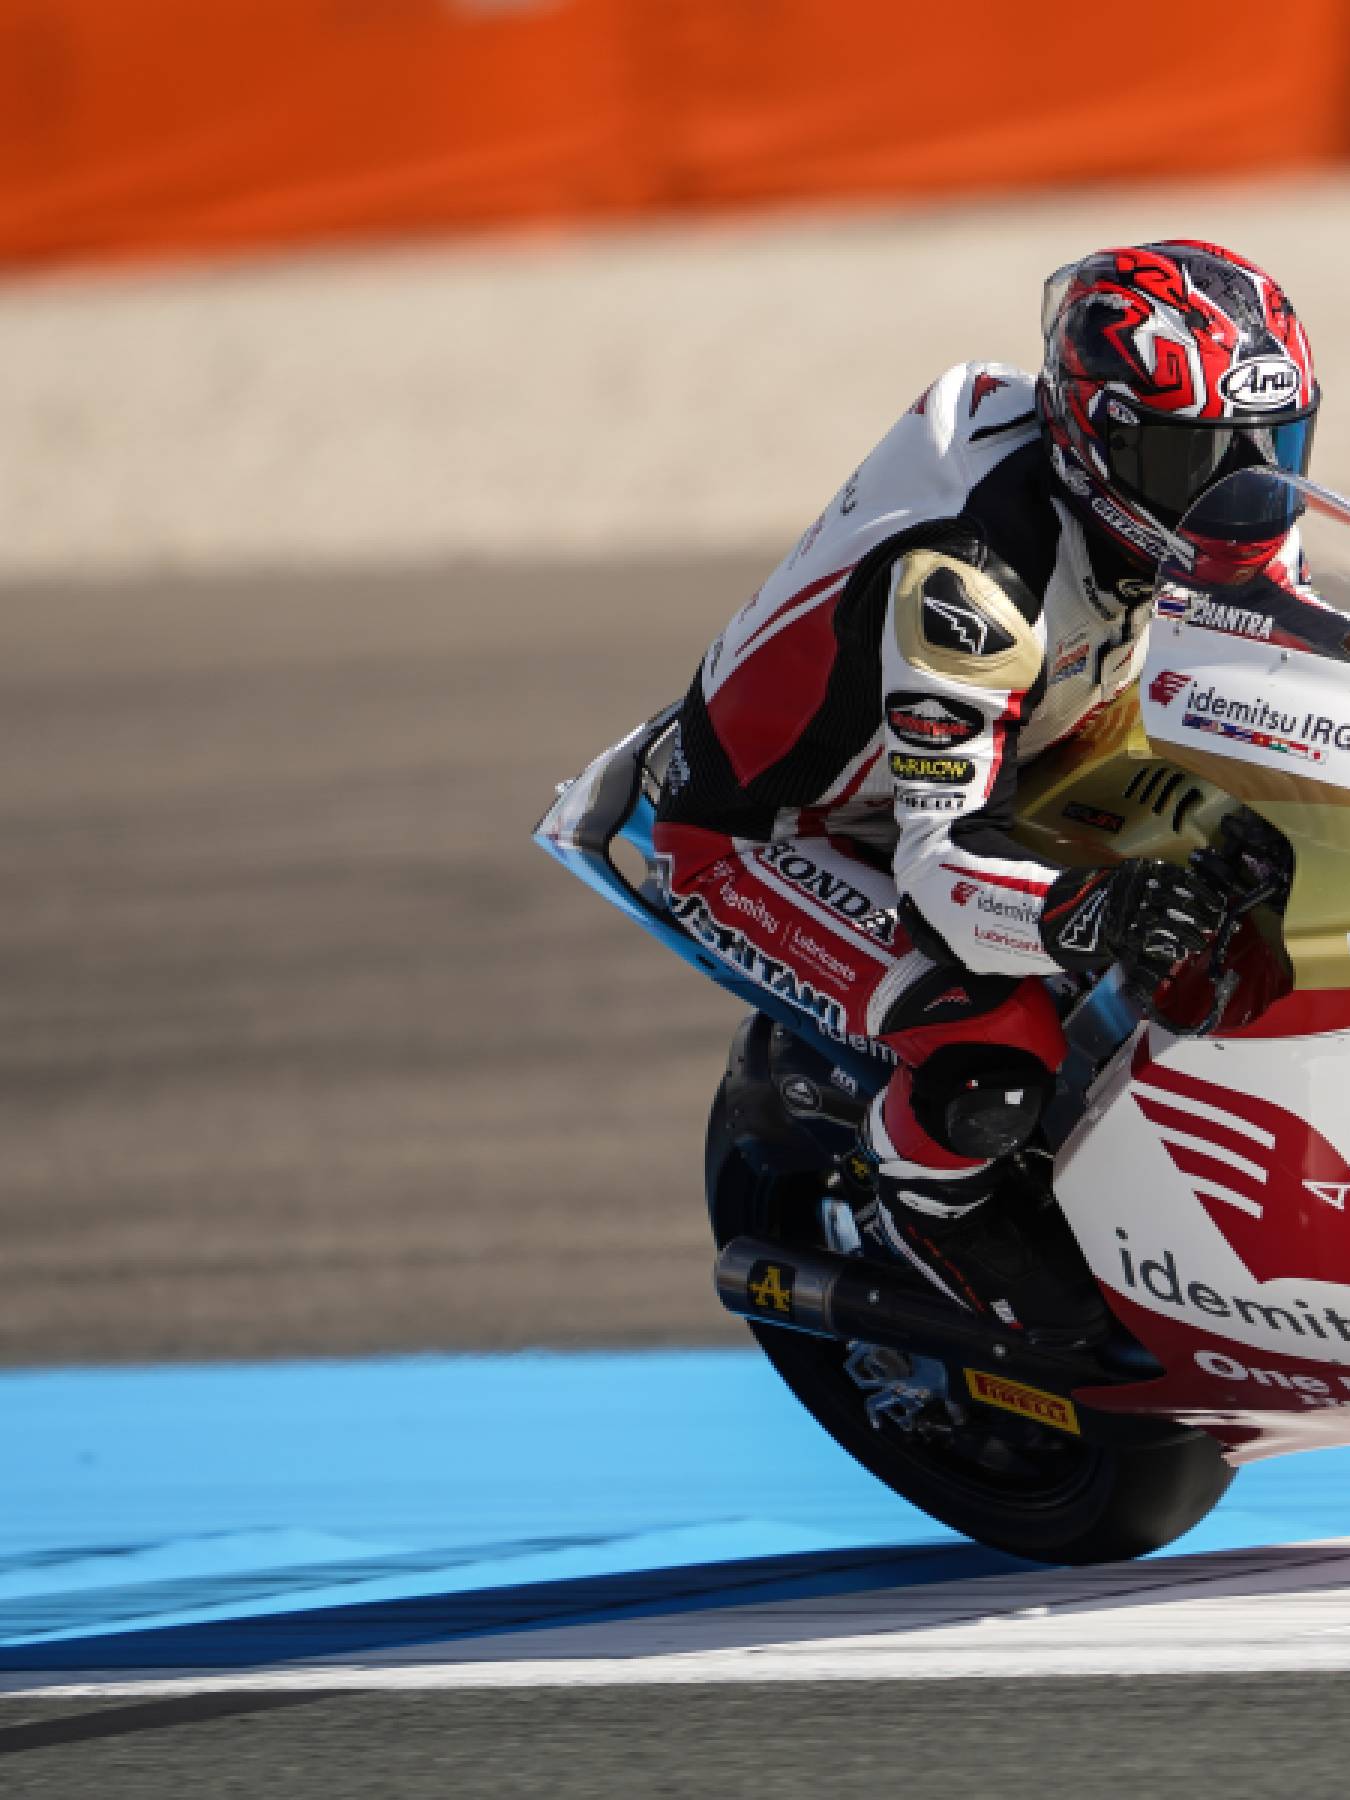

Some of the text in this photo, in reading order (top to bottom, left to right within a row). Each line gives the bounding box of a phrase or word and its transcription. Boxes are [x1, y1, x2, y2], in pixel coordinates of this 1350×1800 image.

[1186, 680, 1298, 734] idemitsu
[1193, 1349, 1331, 1394] One
[973, 1373, 1068, 1426] PIRELLI
